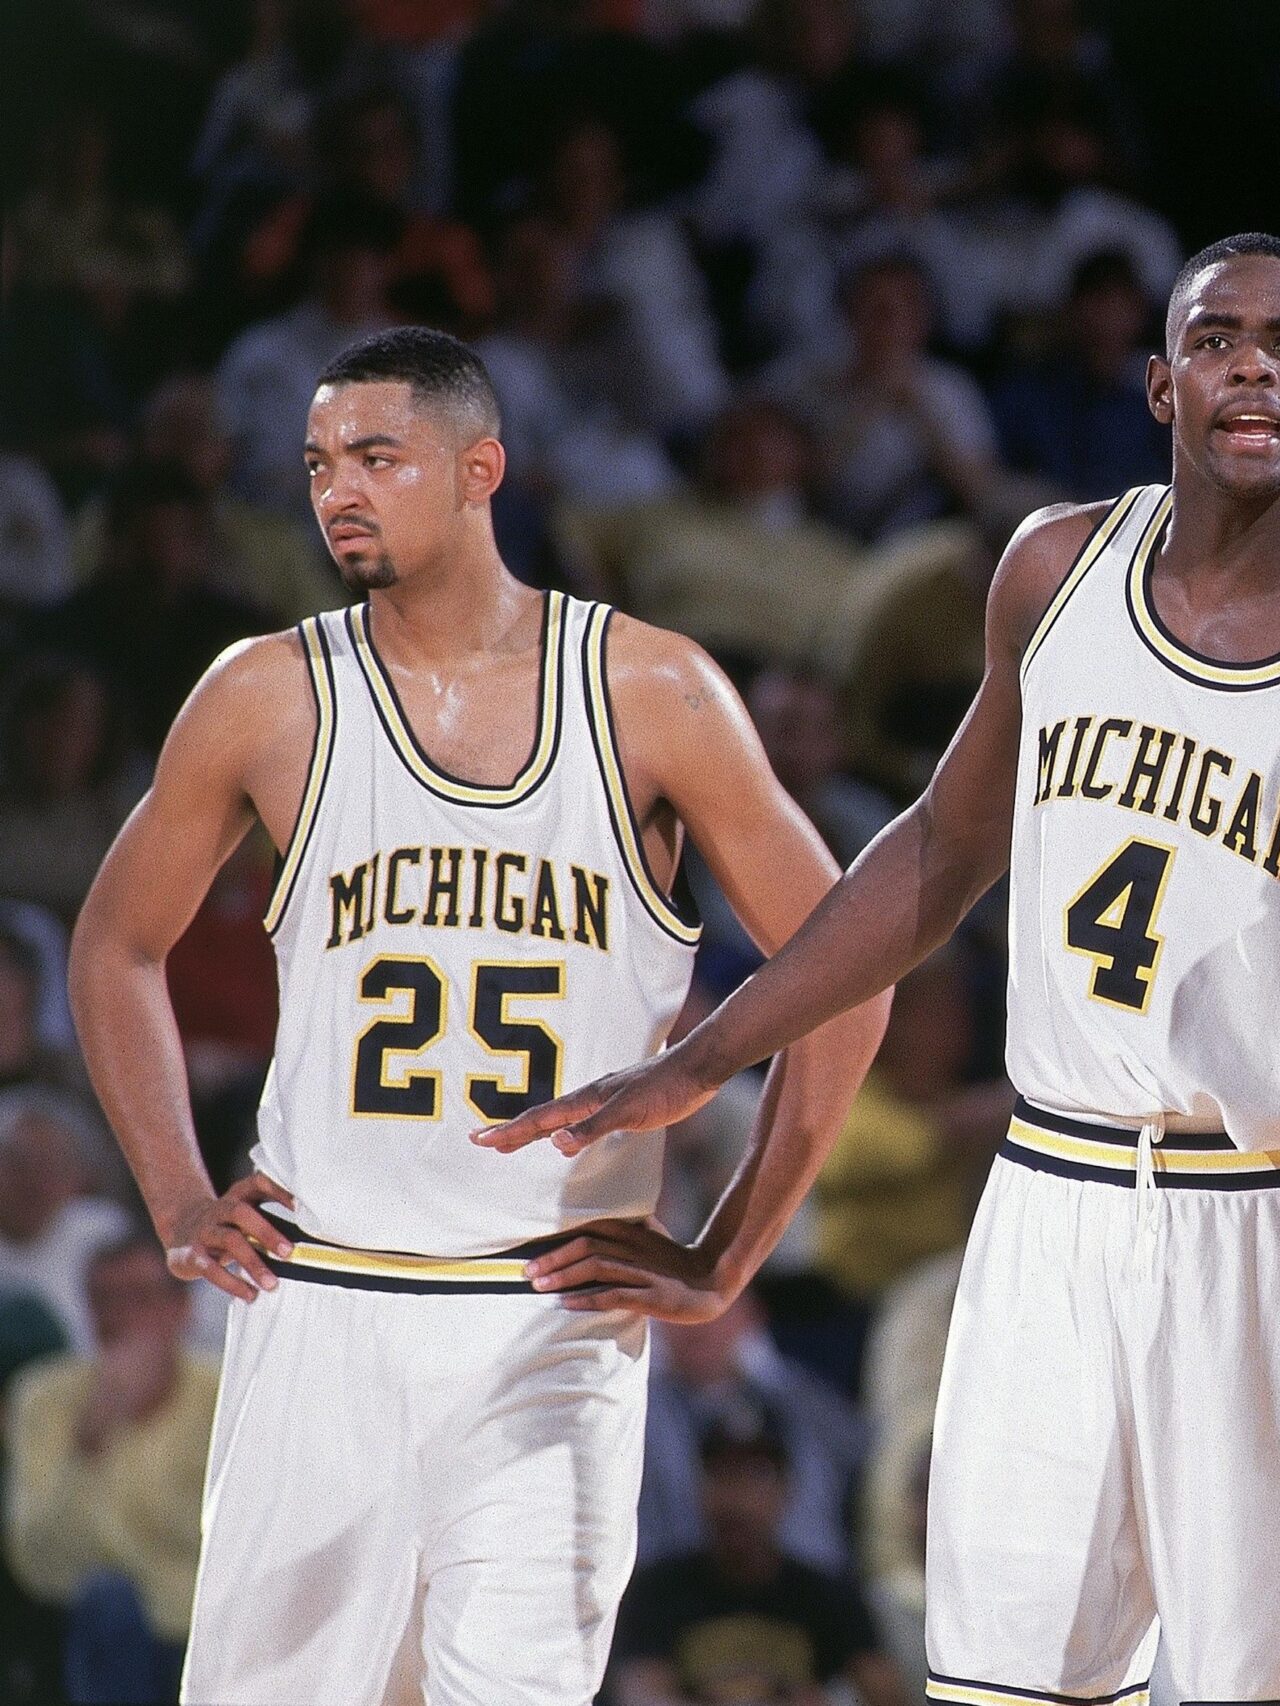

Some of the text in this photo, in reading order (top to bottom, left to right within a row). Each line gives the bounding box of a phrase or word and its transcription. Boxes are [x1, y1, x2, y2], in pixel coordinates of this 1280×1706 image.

[325, 846, 611, 953] MICHIGAN
[1064, 836, 1177, 1013] 4
[350, 954, 566, 1122] 25
